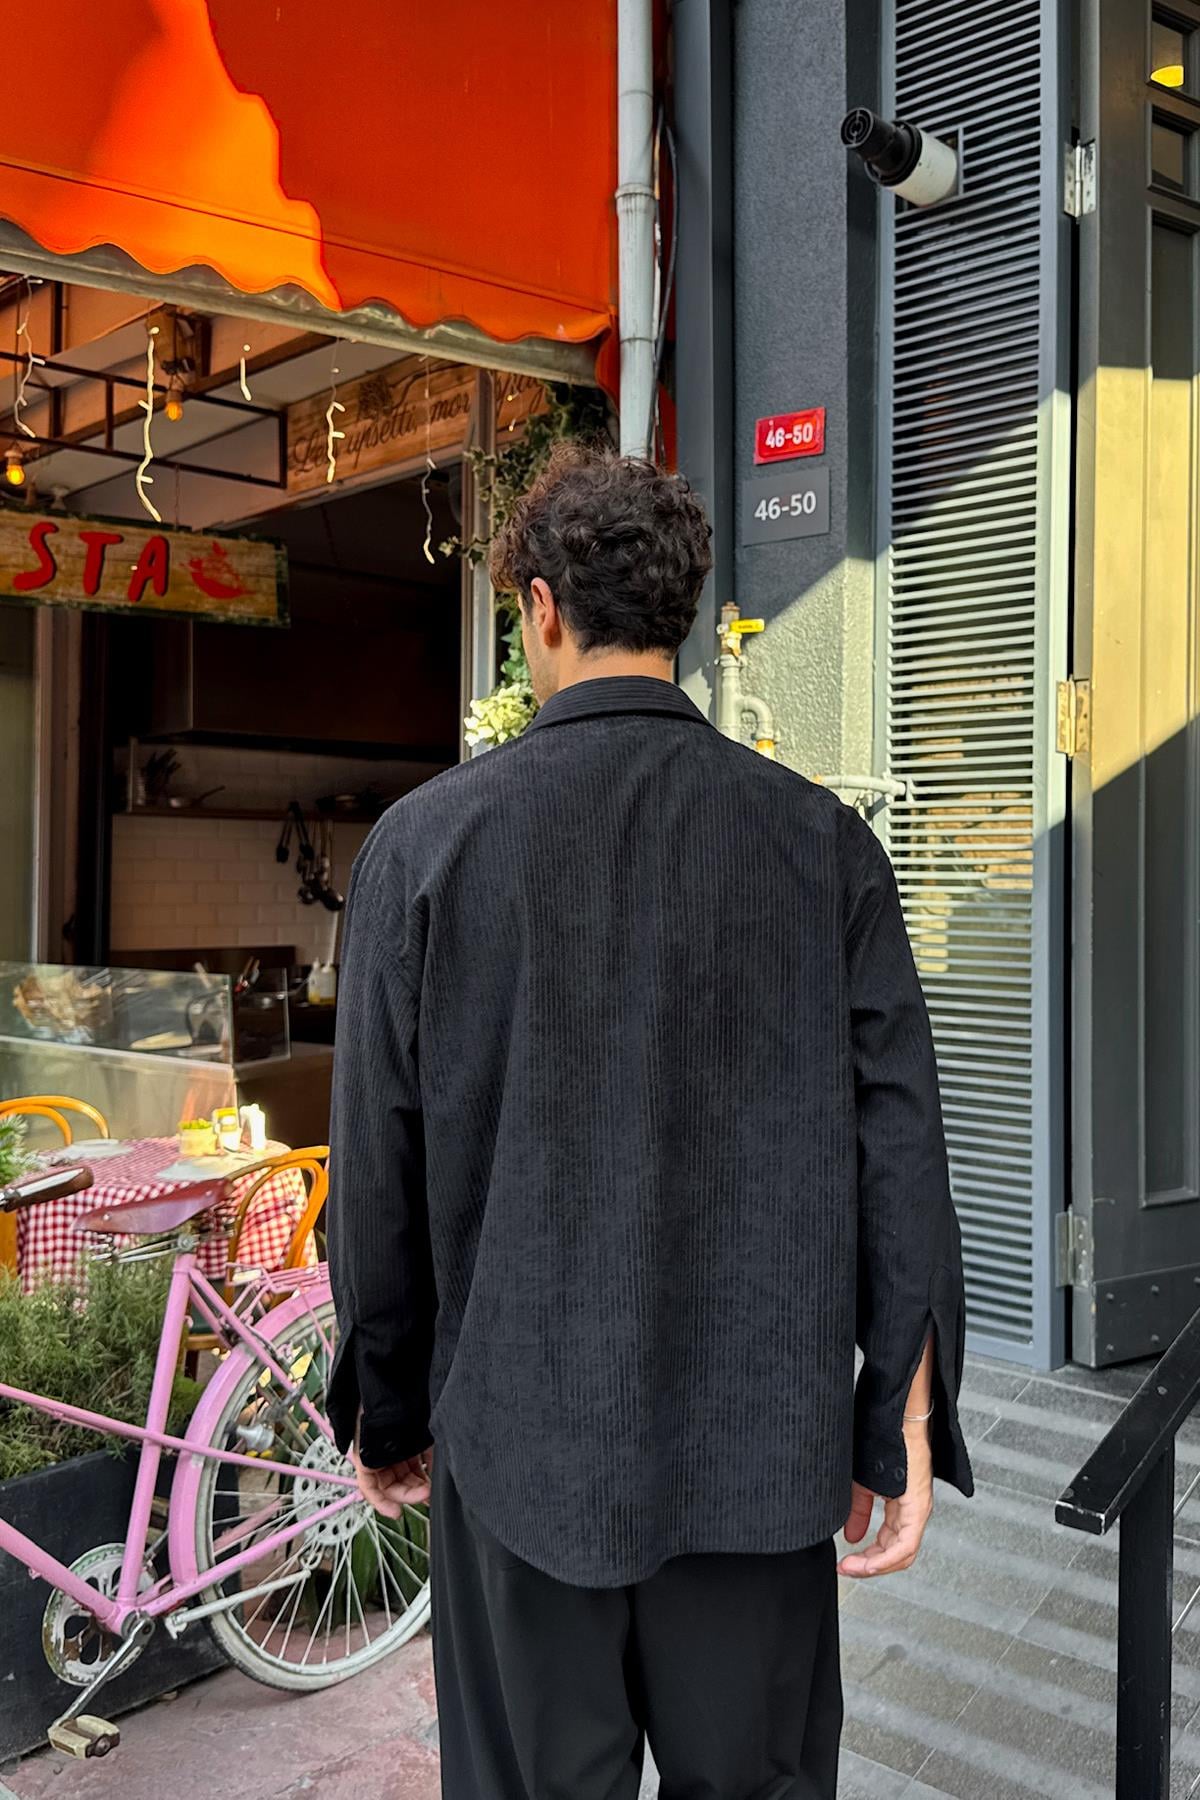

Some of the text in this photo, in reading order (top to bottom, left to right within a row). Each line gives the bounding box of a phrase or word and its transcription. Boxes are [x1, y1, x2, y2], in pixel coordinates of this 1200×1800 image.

[430, 392, 470, 424] mor
[765, 423, 814, 449] 46-50
[754, 490, 817, 521] 46-50
[12, 521, 170, 603] STA
